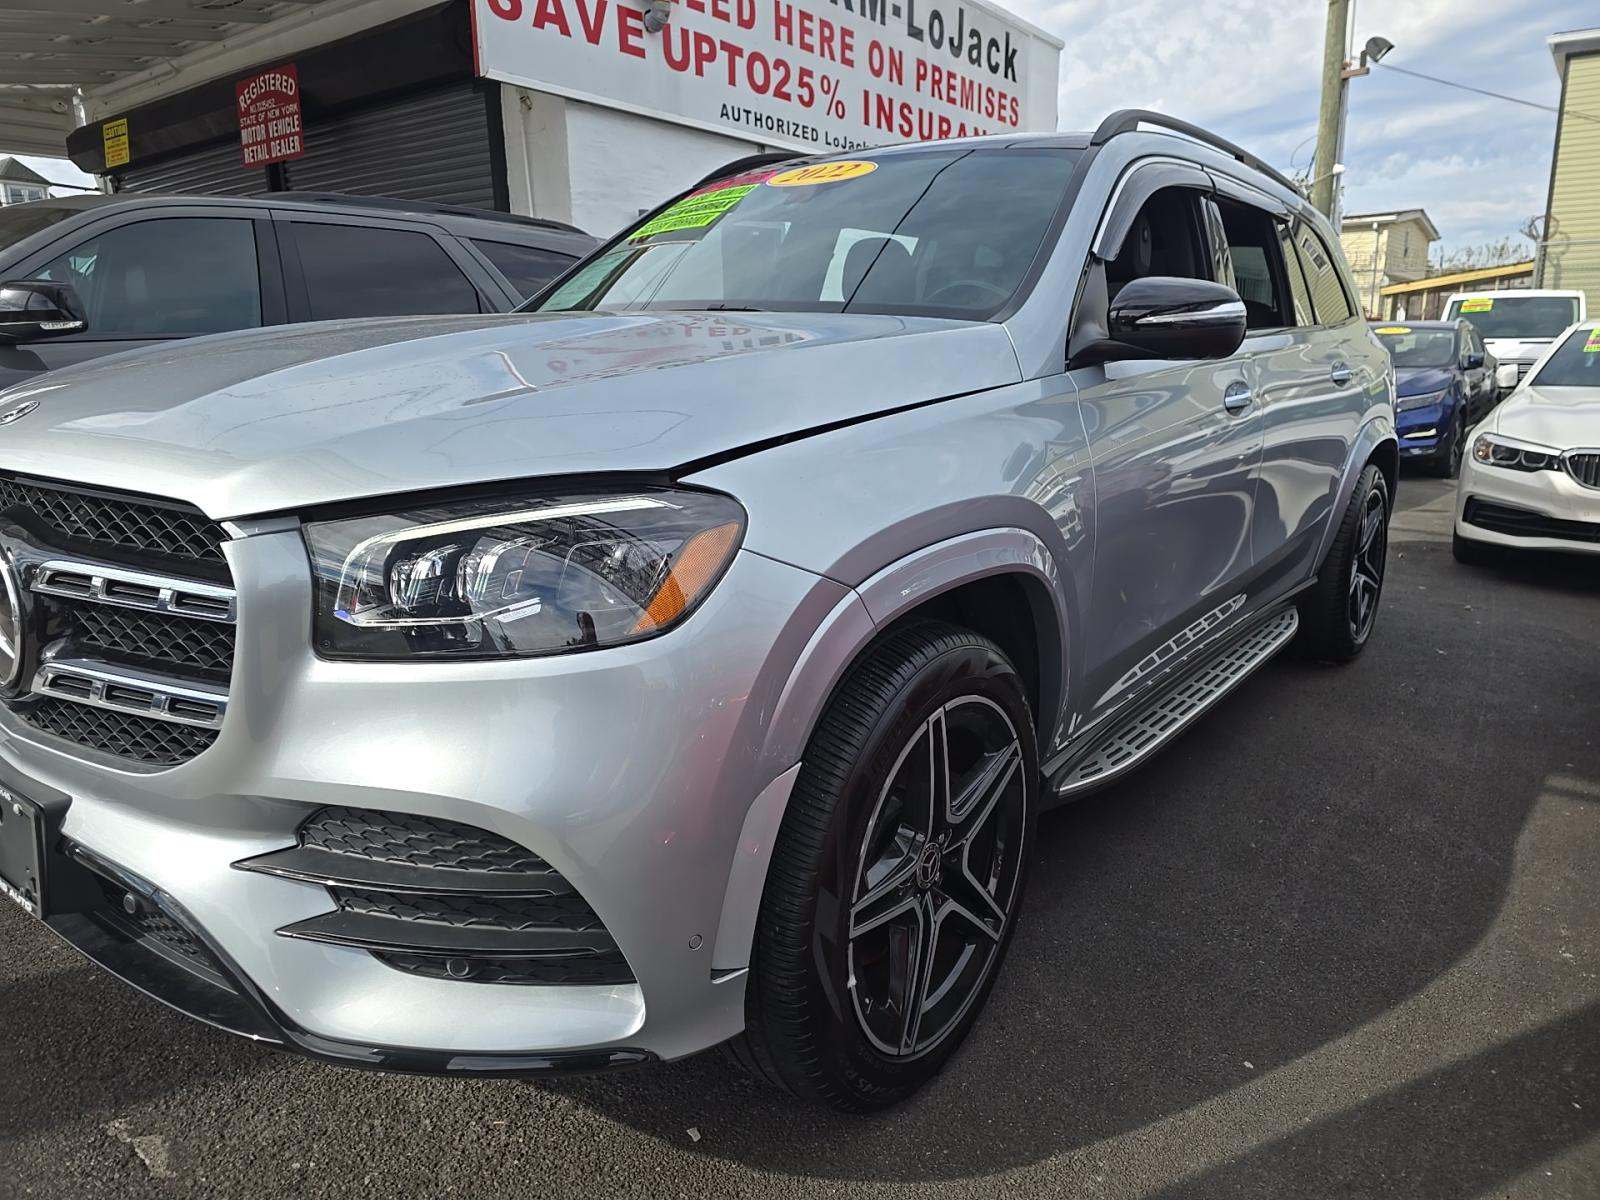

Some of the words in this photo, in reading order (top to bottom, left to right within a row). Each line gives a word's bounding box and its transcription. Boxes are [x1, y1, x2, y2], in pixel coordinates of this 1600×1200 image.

[774, 0, 855, 68] HERE
[868, 40, 903, 86] ON
[916, 57, 1020, 128] PREMISES
[239, 73, 295, 111] REGISTERED
[240, 115, 257, 127] STATE
[258, 111, 266, 122] OF
[268, 108, 280, 119] NEW
[281, 102, 299, 116] YORK
[241, 124, 266, 145] MOTOR
[268, 115, 300, 138] VEHICLE
[720, 103, 819, 142] AUTHORIZED
[863, 89, 988, 141] INSUR
[244, 143, 270, 163] RETAIL
[270, 135, 301, 158] DEALER
[777, 163, 863, 183] 2022
